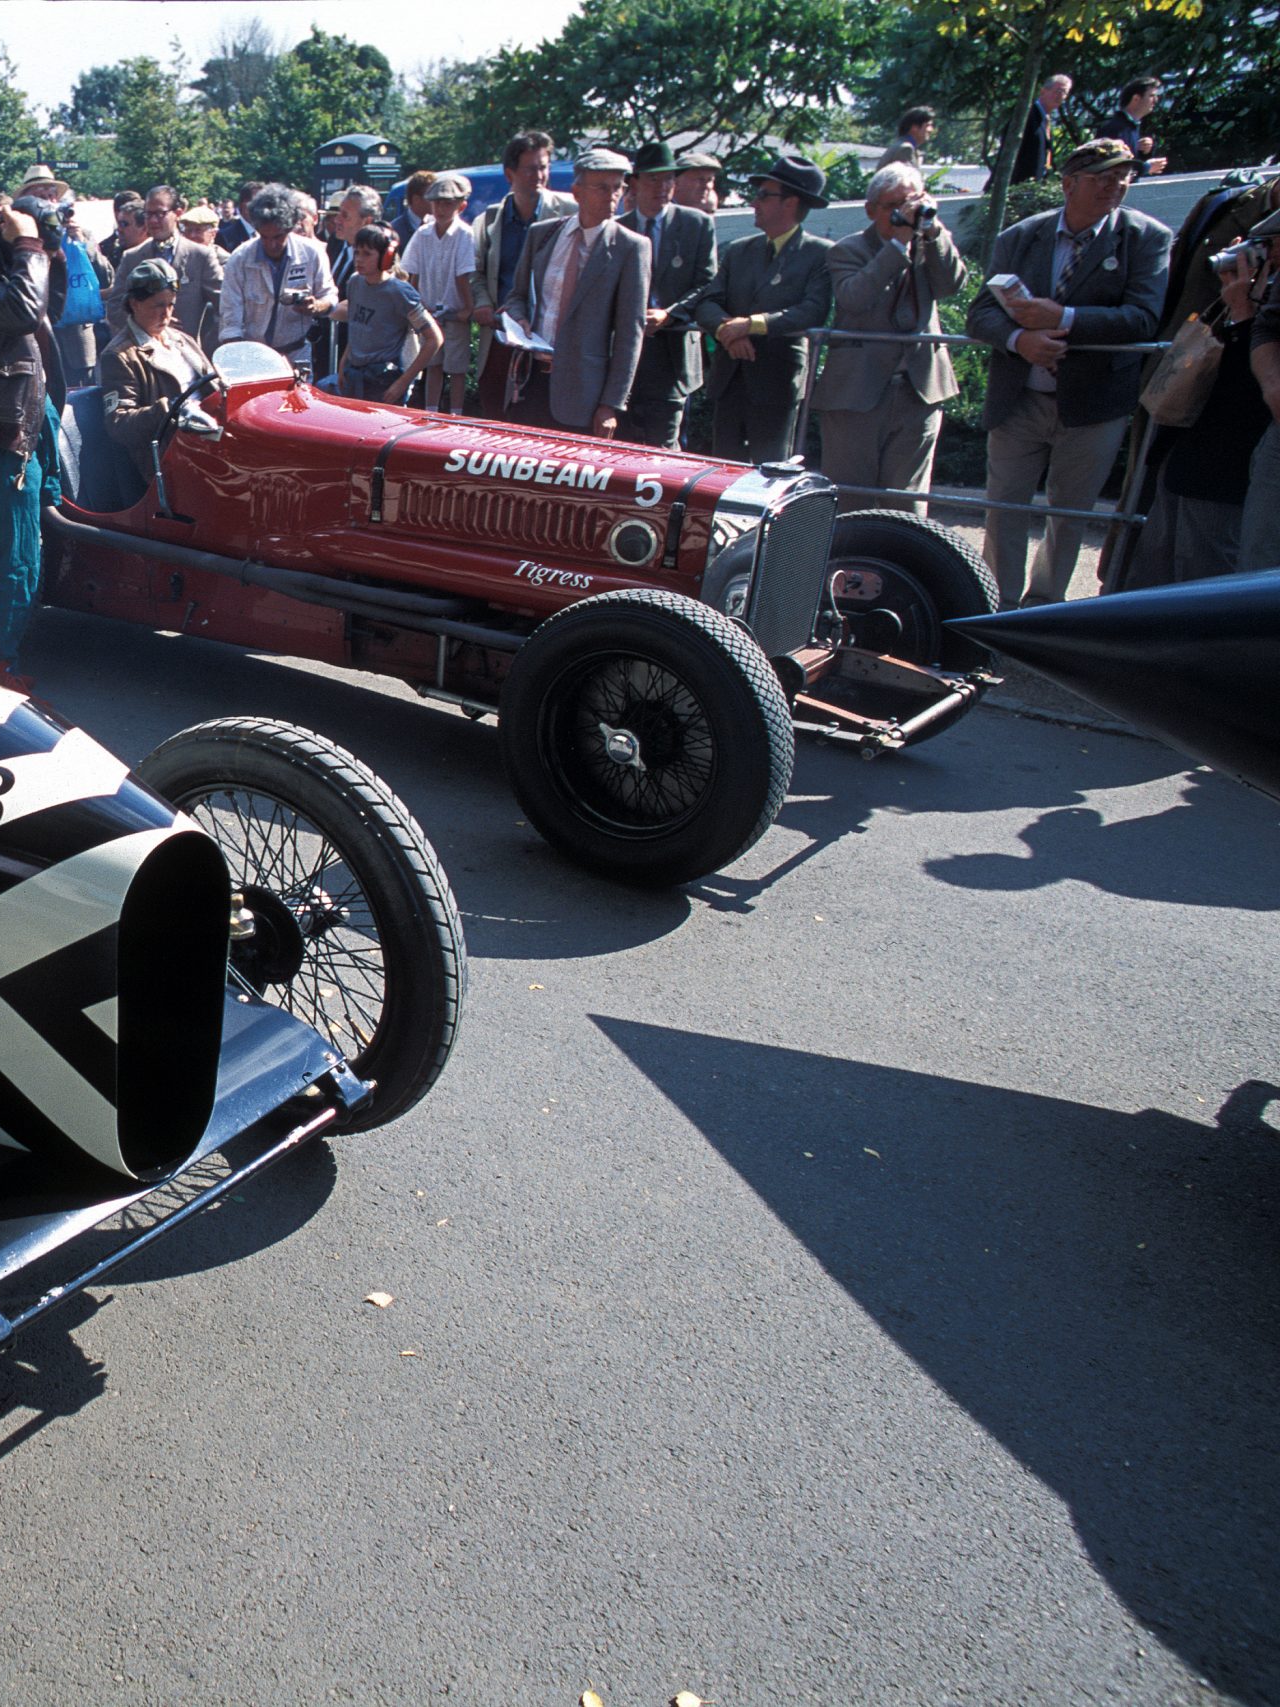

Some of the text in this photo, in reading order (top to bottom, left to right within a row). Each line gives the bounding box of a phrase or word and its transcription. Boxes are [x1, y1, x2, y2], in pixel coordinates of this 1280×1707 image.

[444, 449, 663, 508] SUNBEAM 5
[513, 559, 594, 589] Tigress
